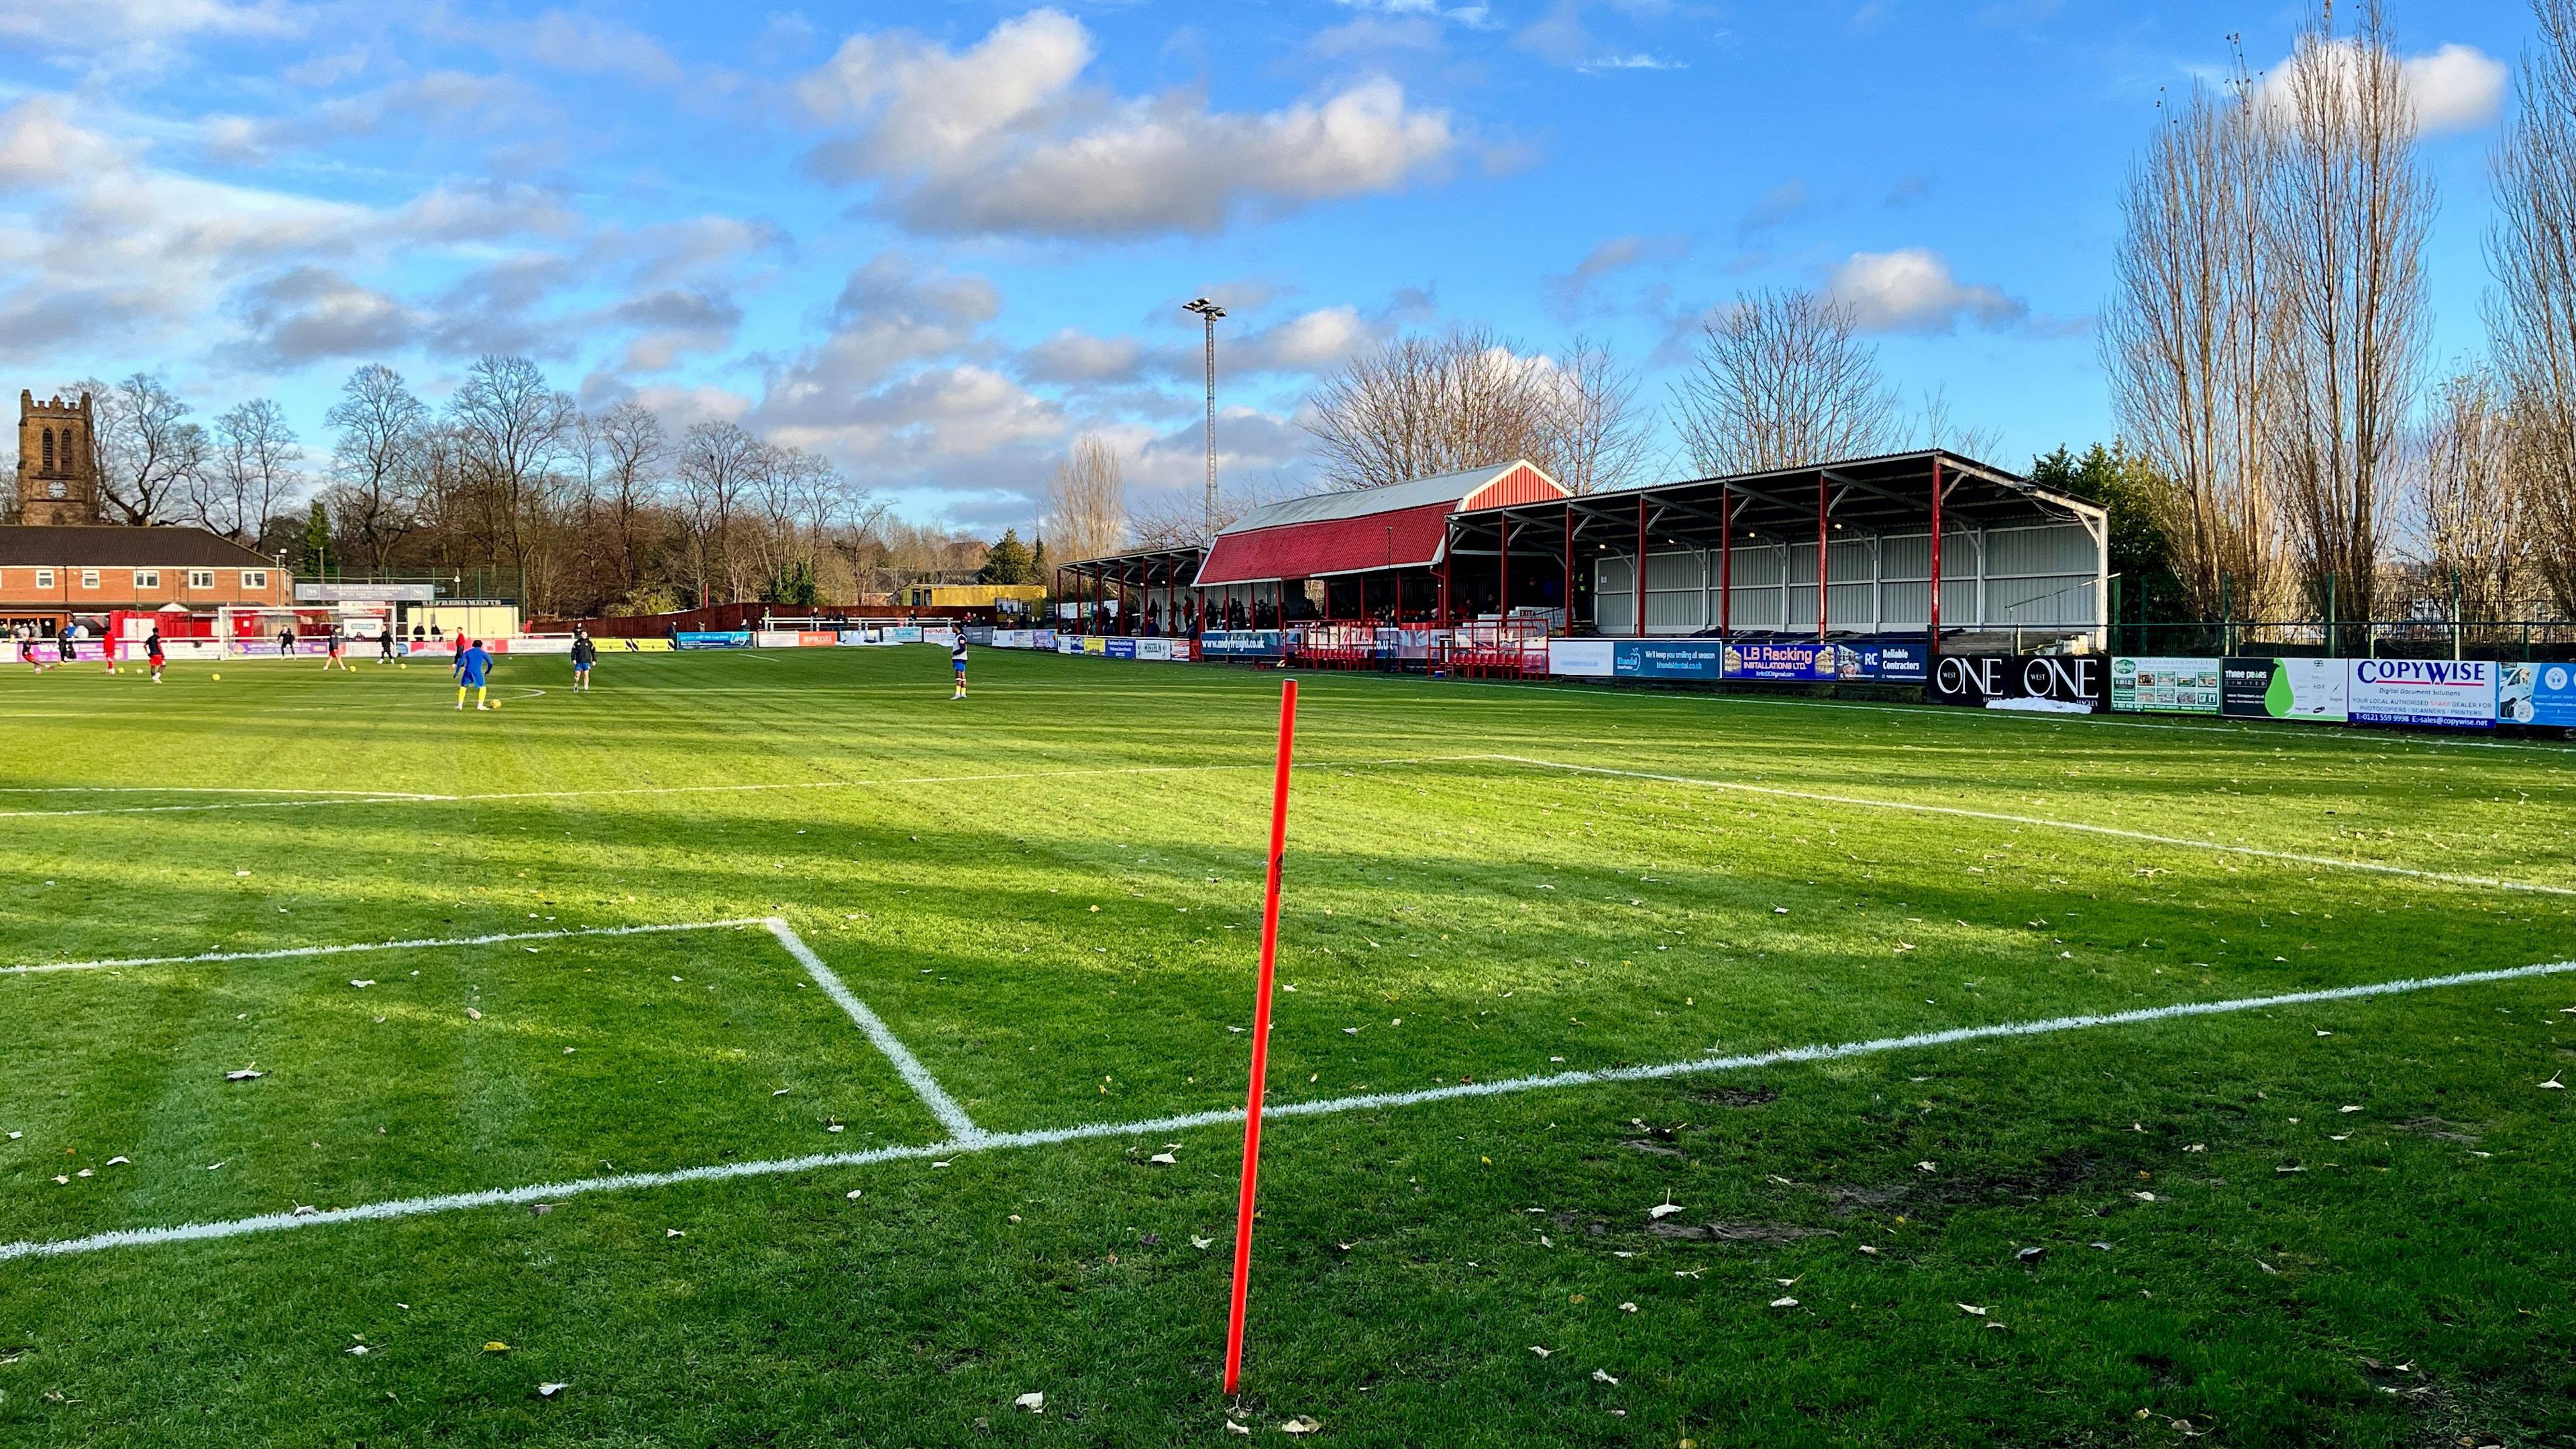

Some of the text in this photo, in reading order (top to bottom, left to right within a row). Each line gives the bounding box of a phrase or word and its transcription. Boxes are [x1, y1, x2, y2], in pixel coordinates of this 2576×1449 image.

[803, 634, 833, 642] avanti
[1201, 635, 1265, 652] www.andyfreight.co.uk
[1675, 651, 1692, 660] smiling
[1743, 647, 1813, 664] LB Racking
[1864, 652, 1878, 665] RC
[1882, 649, 1909, 659] Reliable
[1743, 661, 1807, 670] INSTALLATIONS LTD.
[1882, 660, 1920, 670] Contractors
[1937, 657, 2003, 695] ONE
[2024, 658, 2099, 698] ONE
[2357, 660, 2485, 685] COPYWISE
[2393, 714, 2410, 722] 9998
